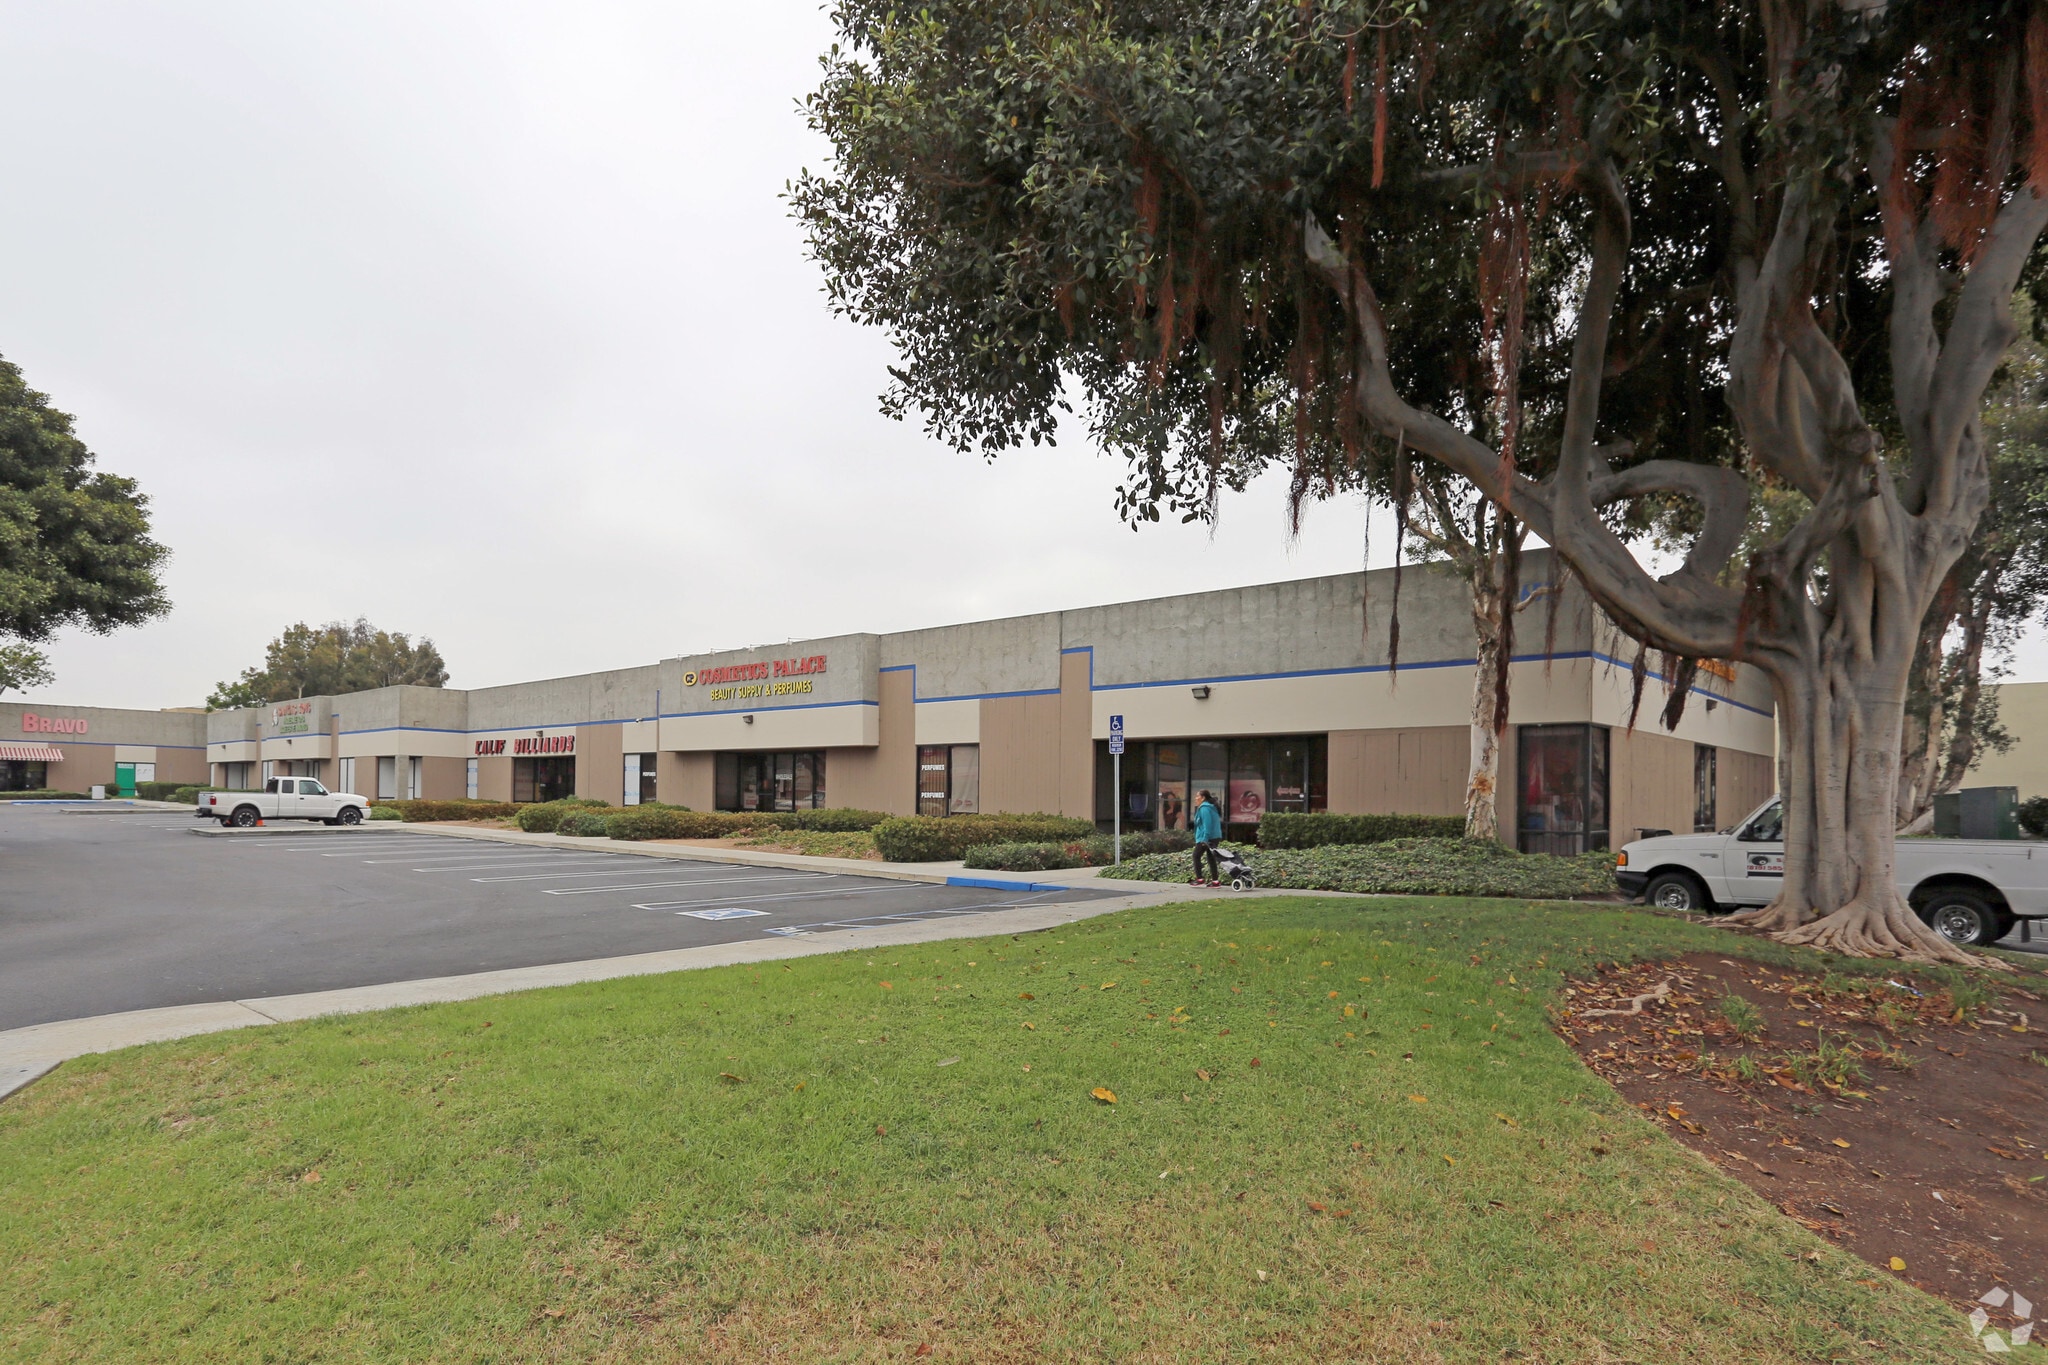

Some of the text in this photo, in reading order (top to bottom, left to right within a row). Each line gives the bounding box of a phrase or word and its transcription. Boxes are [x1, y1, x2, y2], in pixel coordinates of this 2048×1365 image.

[698, 655, 826, 685] COSMETICS PALACE
[710, 681, 812, 700] BEAUTY SUPPLY & PERFUMES
[23, 712, 88, 734] BRAVO
[475, 735, 574, 755] CALIF BILLIARDS
